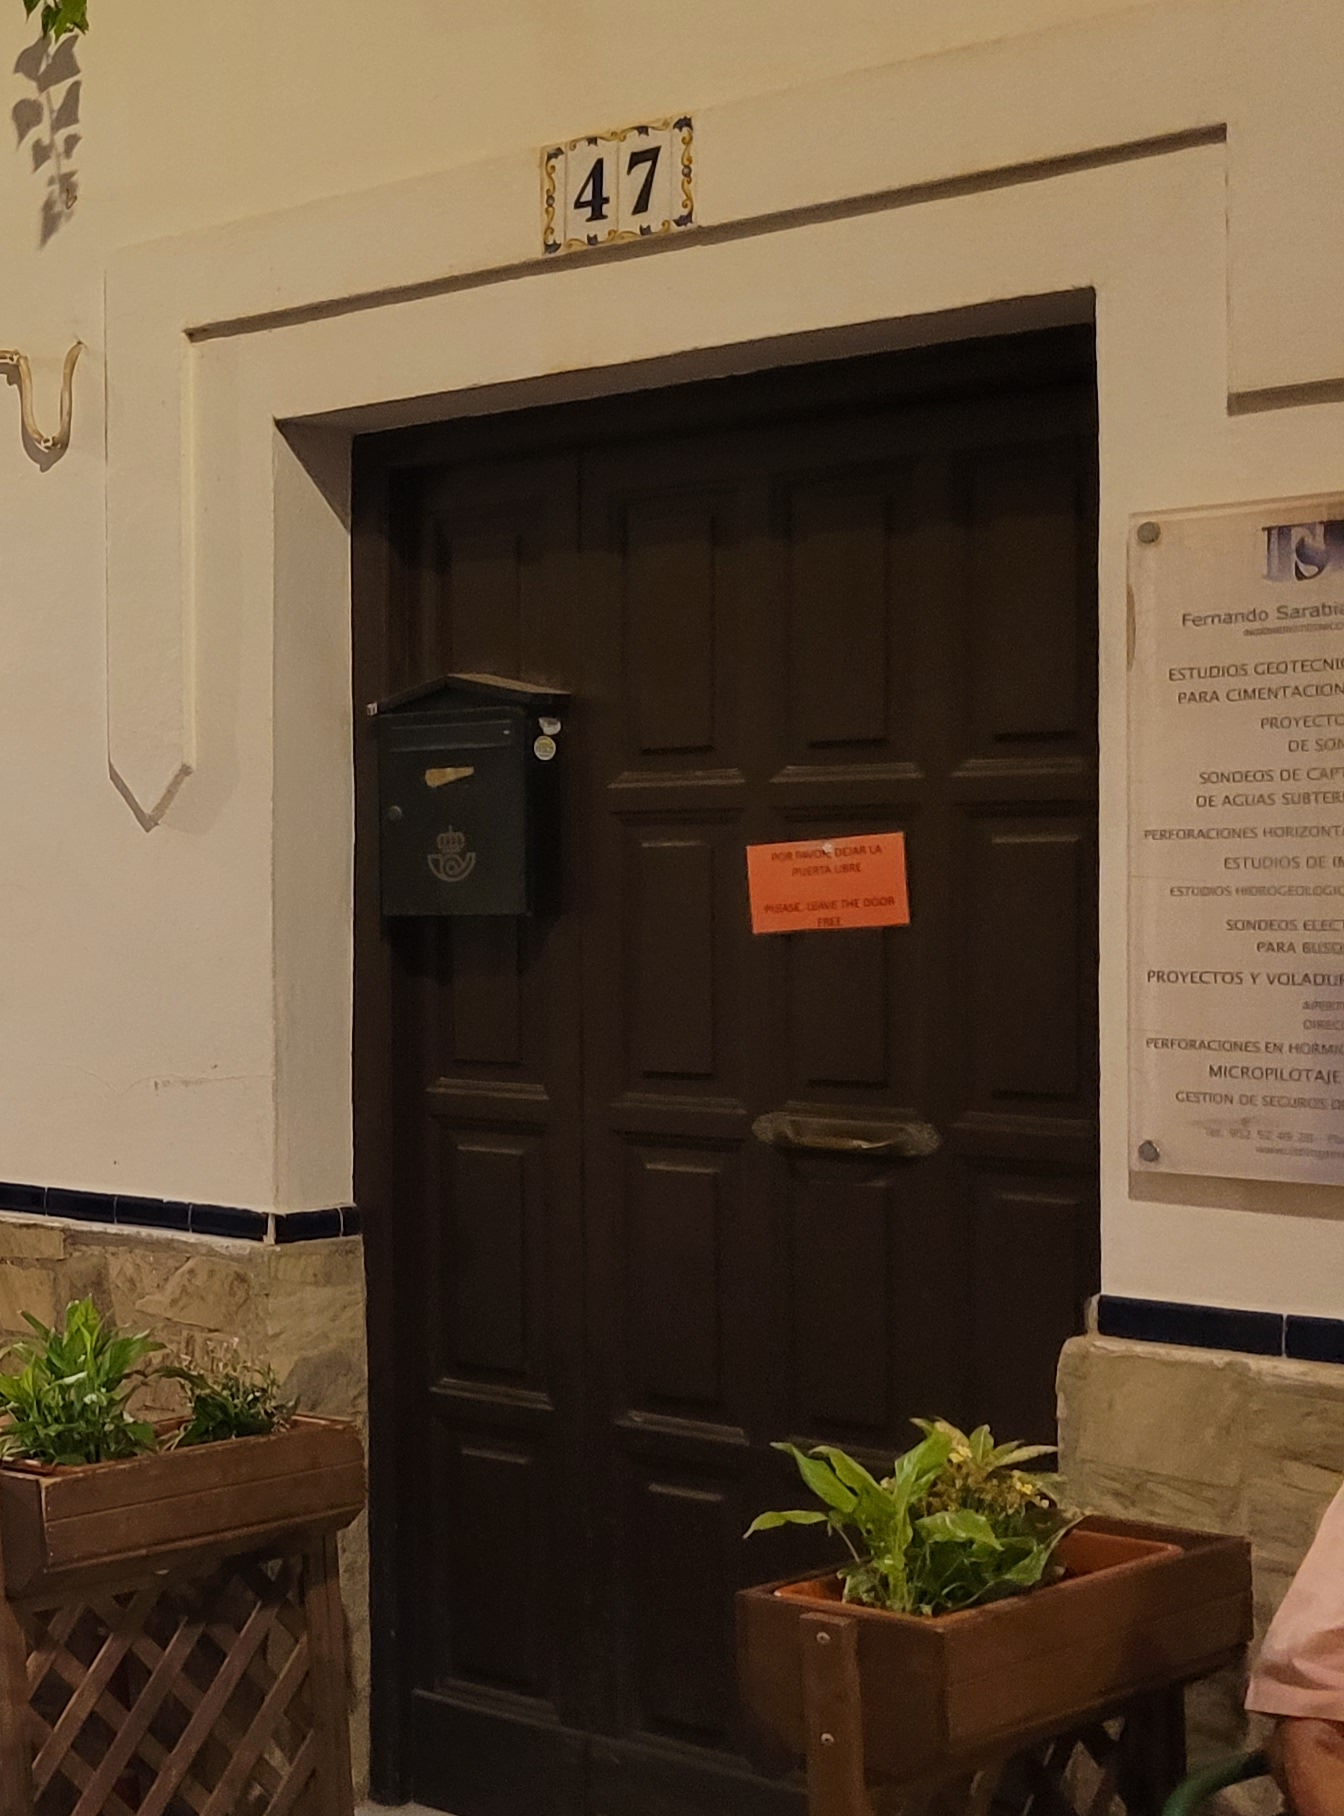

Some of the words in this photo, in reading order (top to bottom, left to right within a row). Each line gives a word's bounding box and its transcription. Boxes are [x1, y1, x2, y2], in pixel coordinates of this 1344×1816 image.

[574, 145, 662, 222] 47
[1182, 607, 1269, 627] Fernando
[1169, 663, 1248, 681] ESTUDIOS
[1254, 657, 1344, 676] GEOTECNI
[1178, 690, 1220, 704] PARA
[1288, 739, 1309, 753] DE
[1199, 769, 1274, 784] SONDEOS
[1280, 768, 1303, 782] DE
[1196, 795, 1217, 808] DE
[1222, 793, 1276, 807] AGUAS
[1144, 827, 1258, 840] PERFORACIONES
[1224, 856, 1300, 869] ESTUDIOS
[1306, 856, 1327, 869] DE
[792, 865, 832, 877] PUERTA
[835, 863, 862, 874] LIBRE
[1170, 886, 1231, 897] ESTUDIOS
[840, 898, 861, 909] THE
[817, 917, 841, 928] FREE
[1225, 919, 1298, 931] SONDEOS
[1256, 941, 1296, 954] PARA
[1147, 970, 1243, 986] PROYECTOS
[1249, 972, 1261, 985] Y
[1146, 1038, 1262, 1053] PERFORACIONES
[1265, 1041, 1283, 1055] EN
[1209, 1064, 1341, 1085] MICROPILOTAJE
[1175, 1090, 1233, 1105] GESTION
[1239, 1093, 1258, 1106] DE
